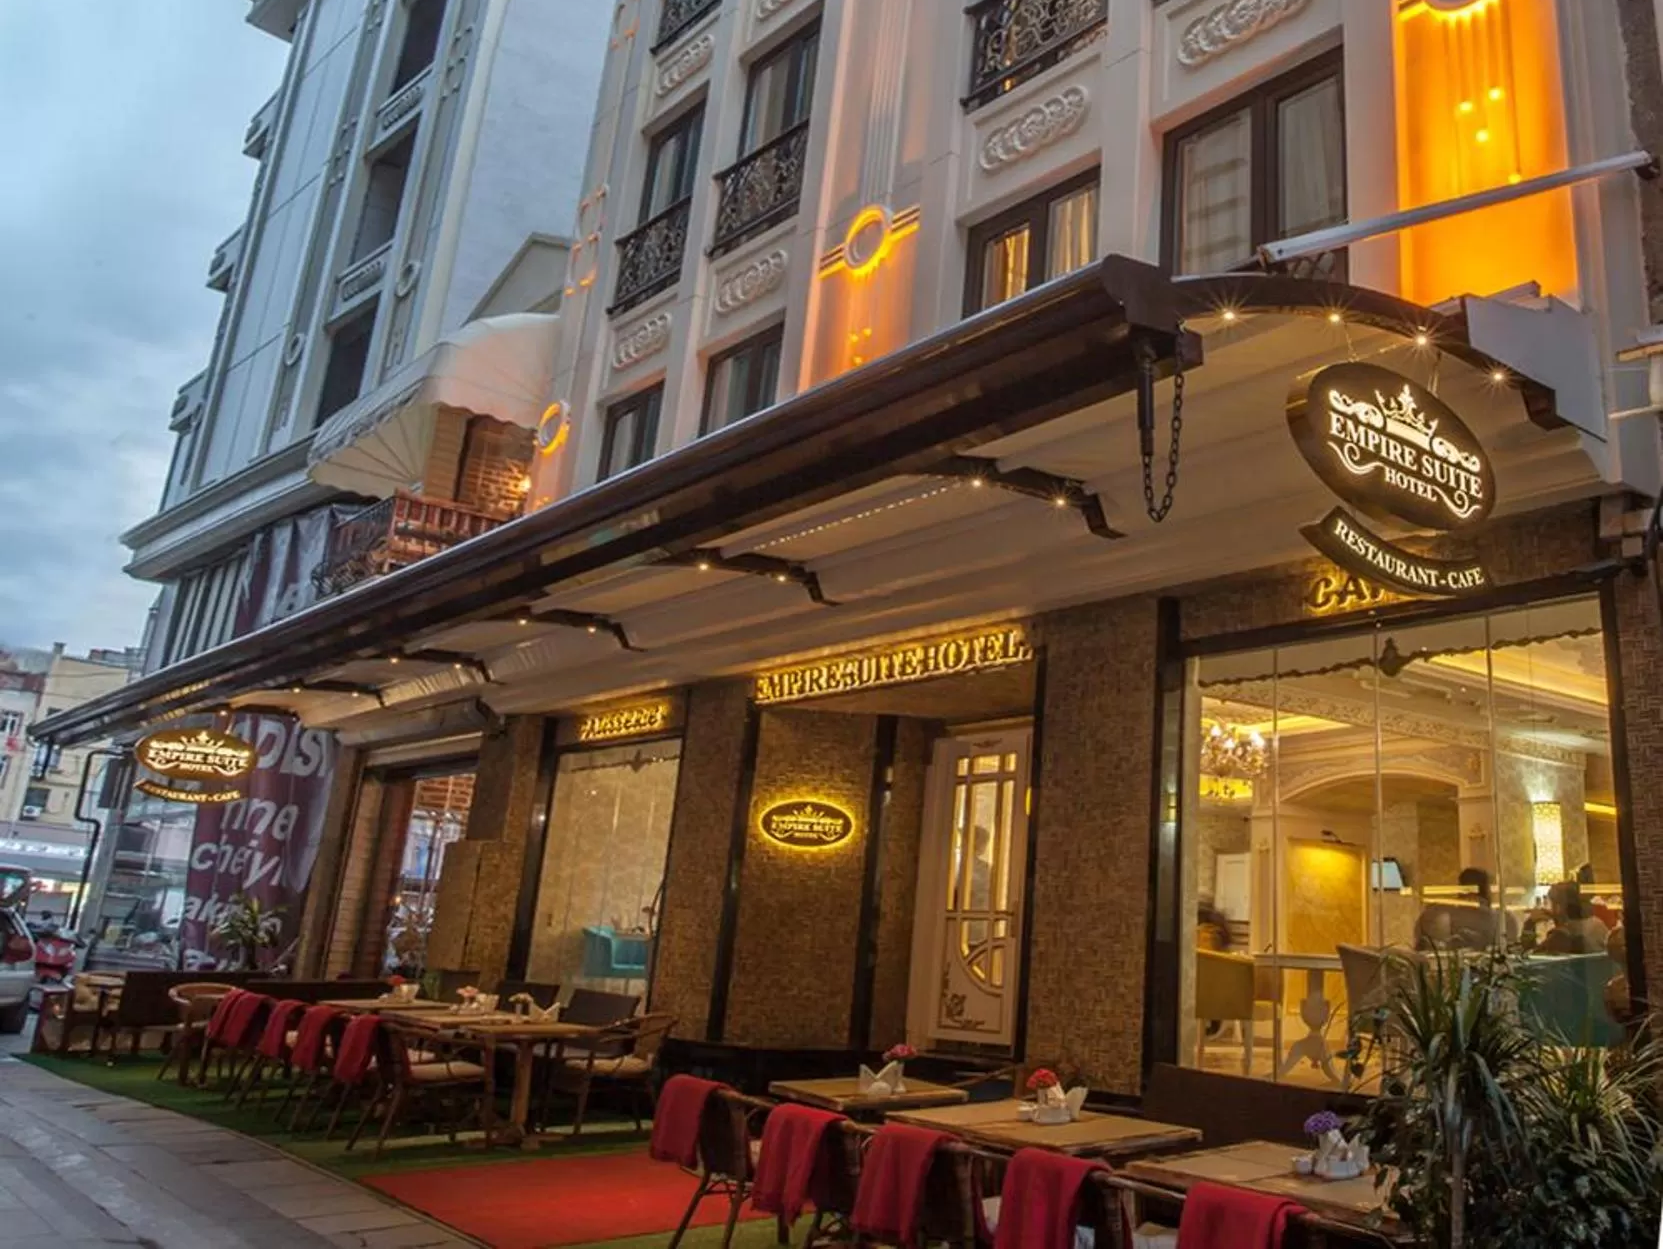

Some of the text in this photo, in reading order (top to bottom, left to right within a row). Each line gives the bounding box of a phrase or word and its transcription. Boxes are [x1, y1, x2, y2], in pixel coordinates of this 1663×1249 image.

[1329, 411, 1484, 500] EMPIRE SUITE
[1384, 467, 1437, 501] HOTEL
[148, 748, 249, 767] EMPIRE SUITE
